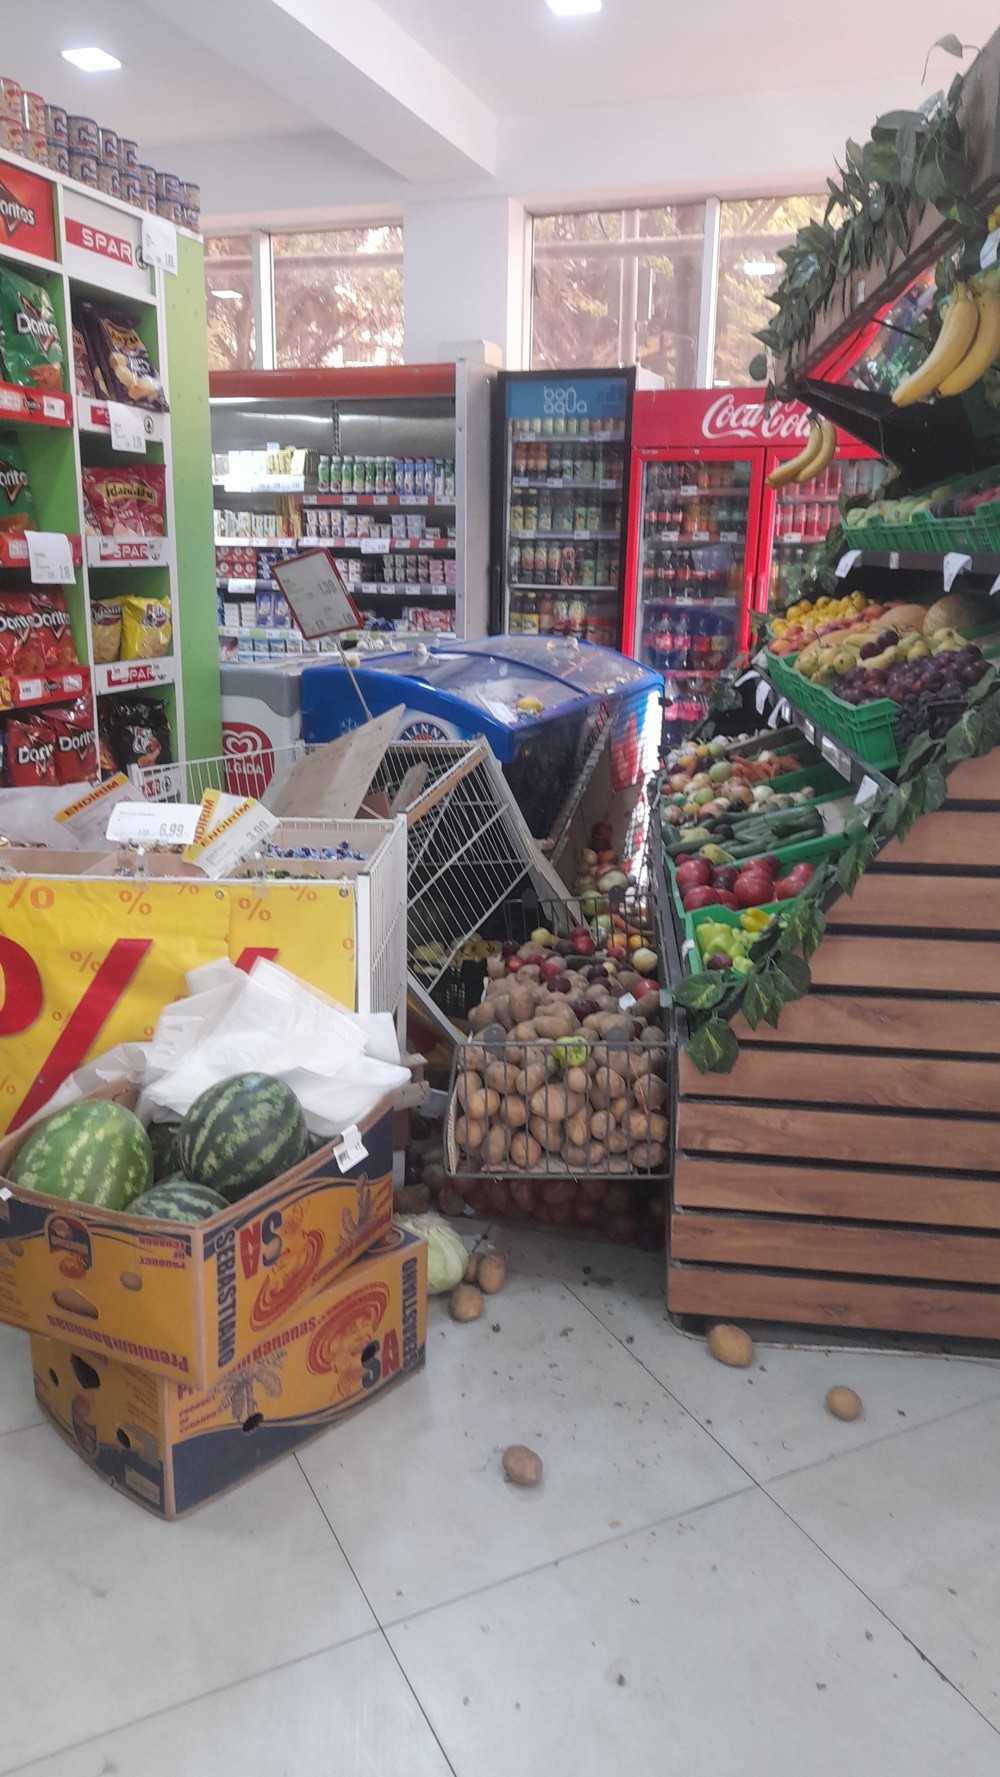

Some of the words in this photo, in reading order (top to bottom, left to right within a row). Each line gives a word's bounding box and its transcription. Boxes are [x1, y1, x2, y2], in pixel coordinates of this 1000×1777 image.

[81, 228, 133, 262] SPAR
[15, 311, 60, 339] Dorito
[544, 386, 577, 401] bon
[544, 399, 588, 417] aqua
[113, 545, 148, 559] SPAR
[226, 761, 264, 775] LGIDA
[159, 823, 185, 837] 6.99
[215, 1226, 237, 1369] SEBASTIANO
